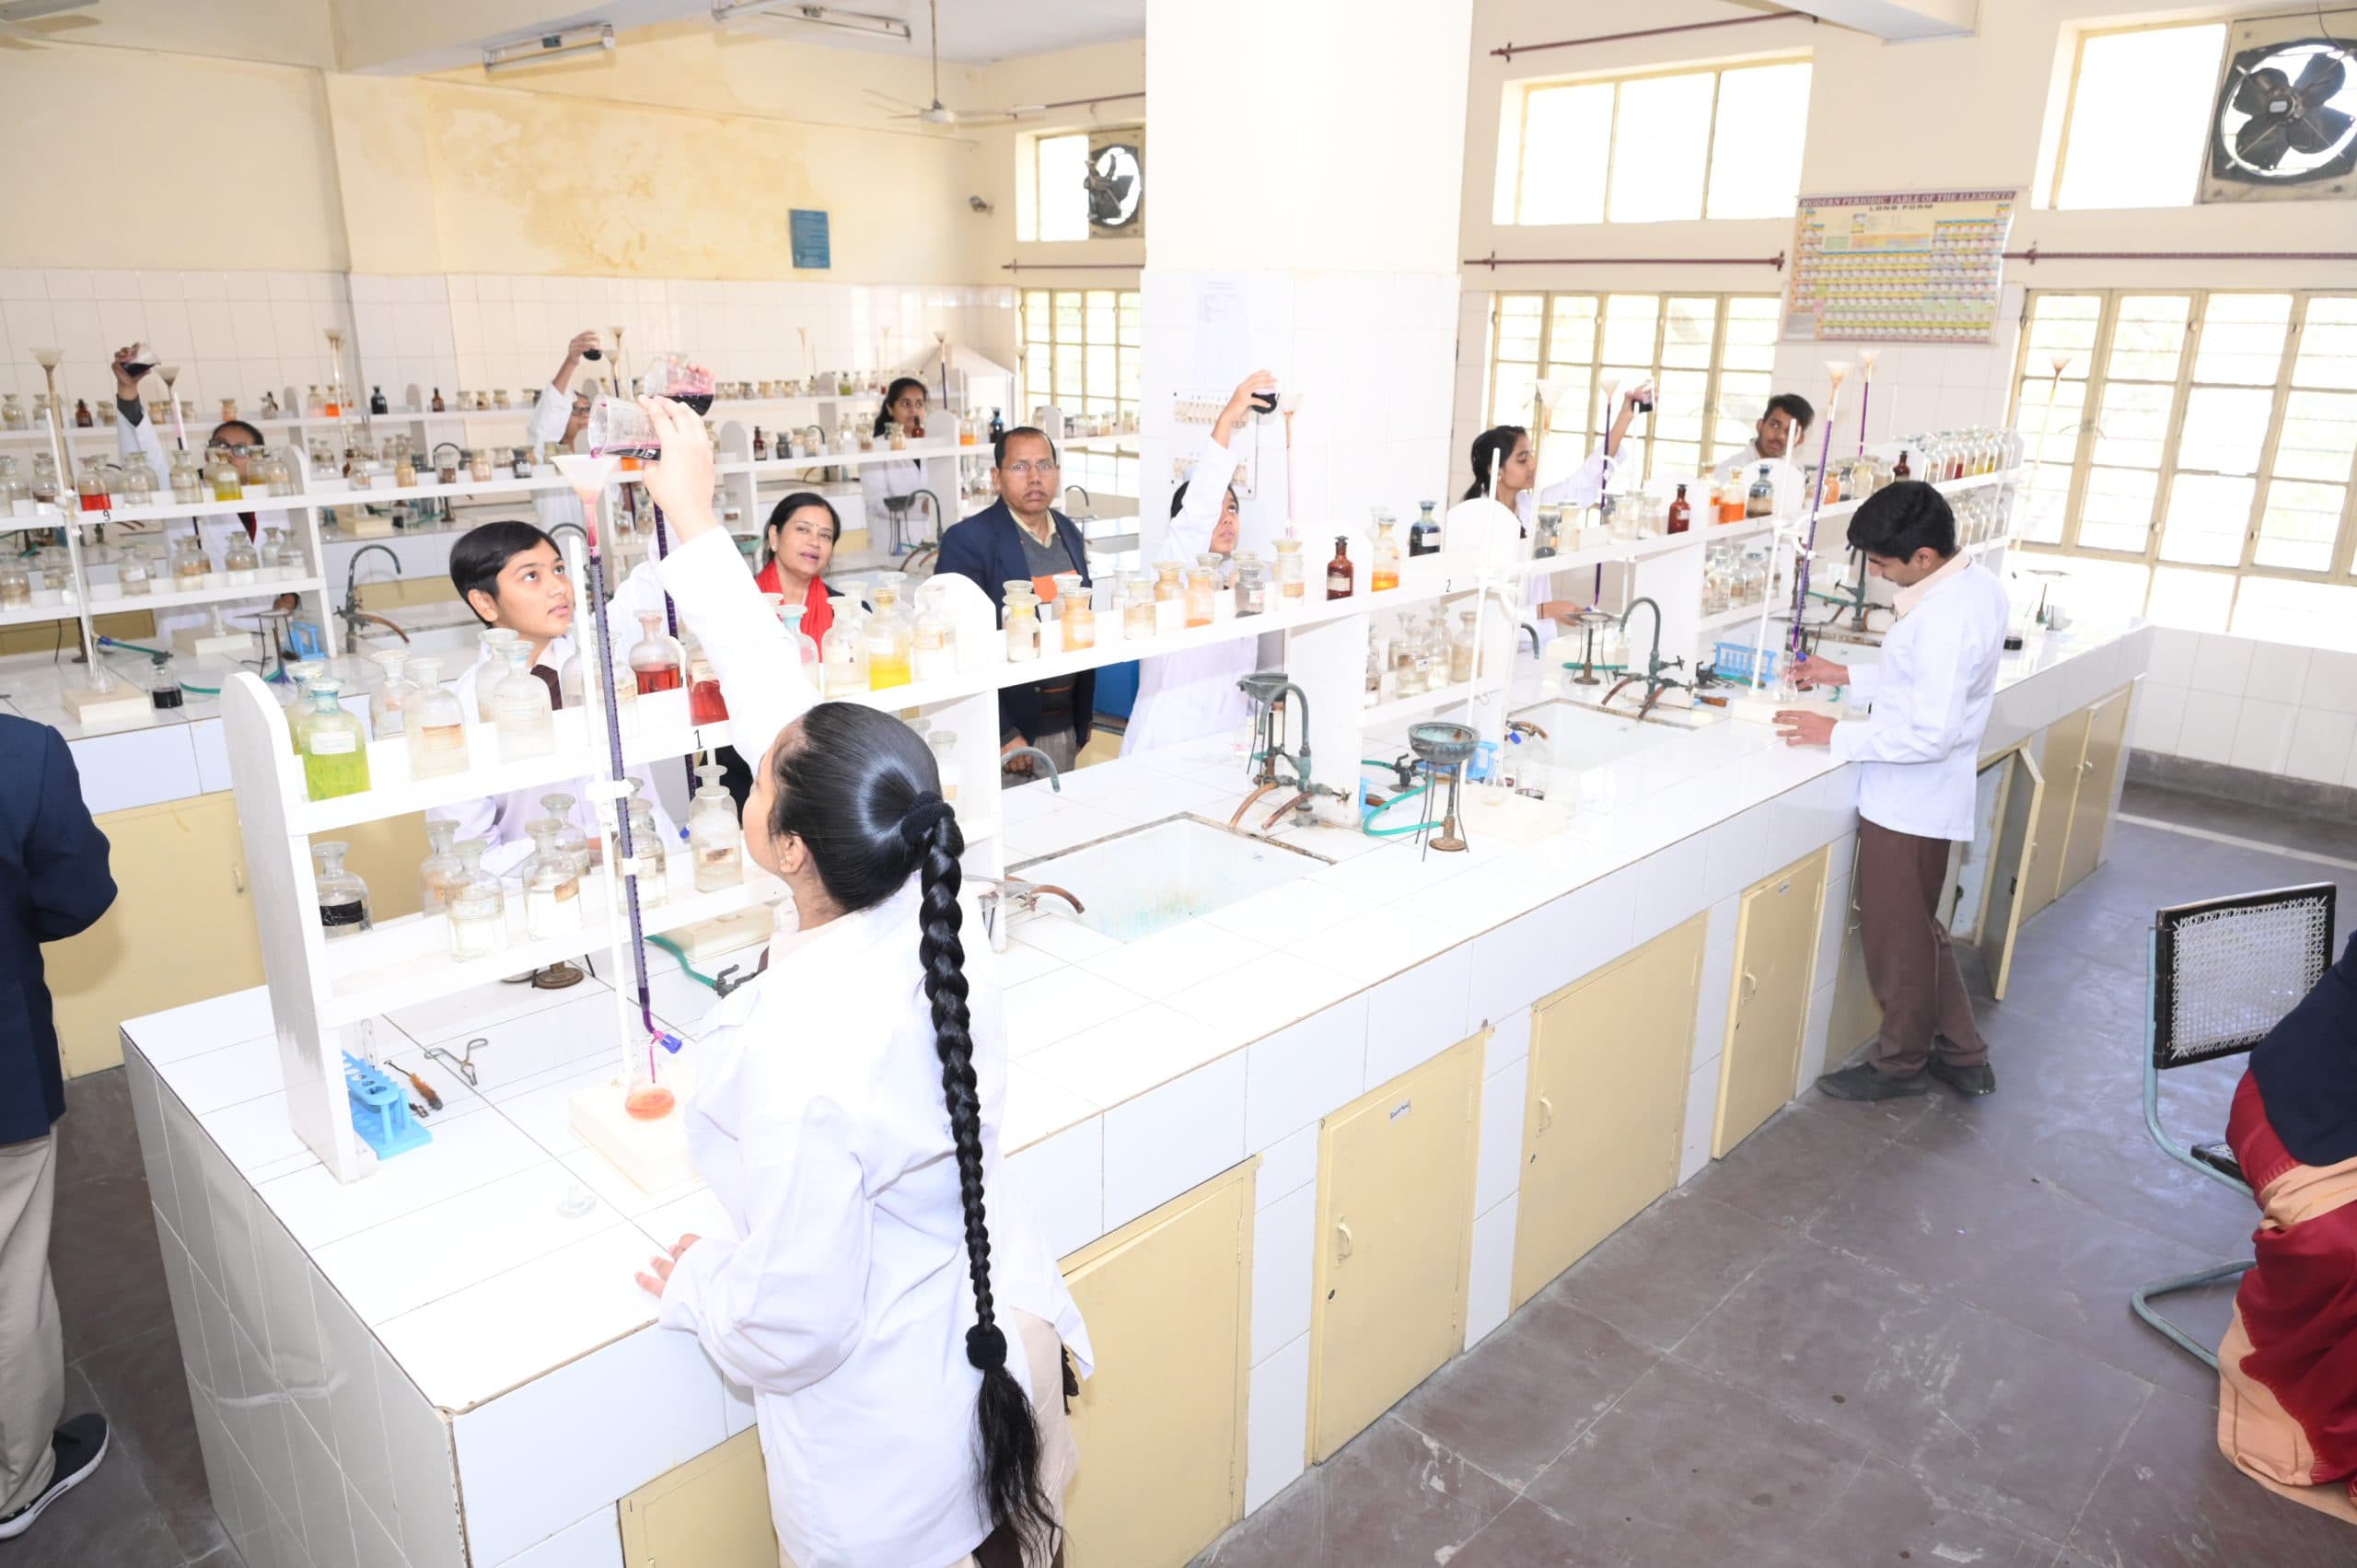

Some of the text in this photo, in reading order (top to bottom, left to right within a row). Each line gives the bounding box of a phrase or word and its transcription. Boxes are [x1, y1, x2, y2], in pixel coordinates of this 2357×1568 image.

[1801, 192, 2014, 207] MODERN PERIODIC TABLE OF THE ELEMENTS
[693, 728, 704, 750] 1
